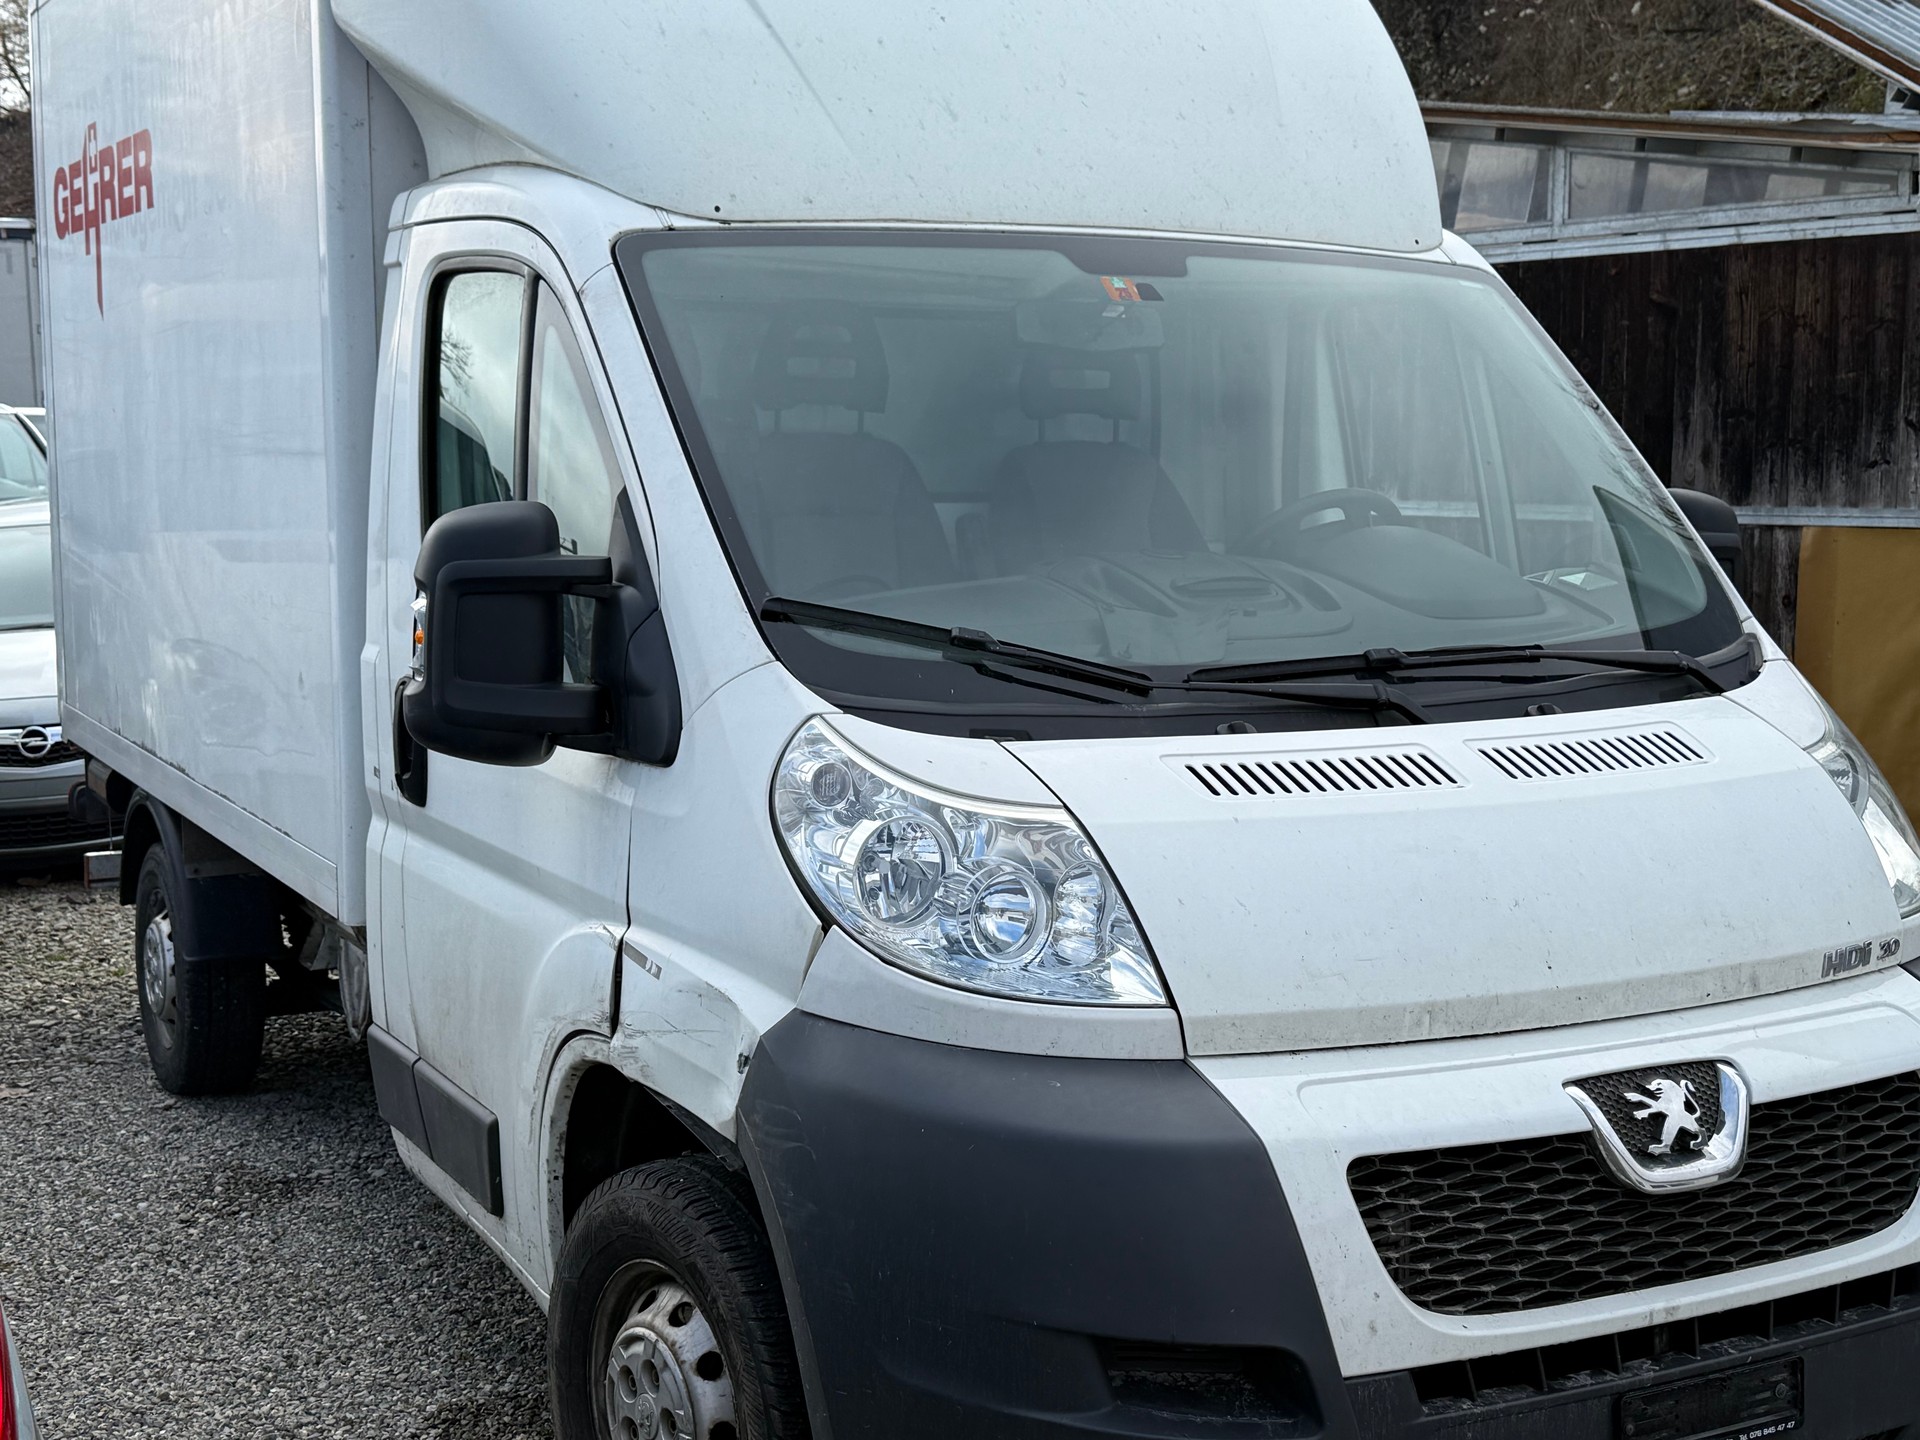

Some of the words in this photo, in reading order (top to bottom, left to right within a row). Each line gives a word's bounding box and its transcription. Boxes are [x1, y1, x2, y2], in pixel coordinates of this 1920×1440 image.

[53, 121, 155, 320] GEHRER
[1821, 940, 1873, 978] HDi
[1763, 1426, 1776, 1435] 845
[1777, 1423, 1785, 1431] 47
